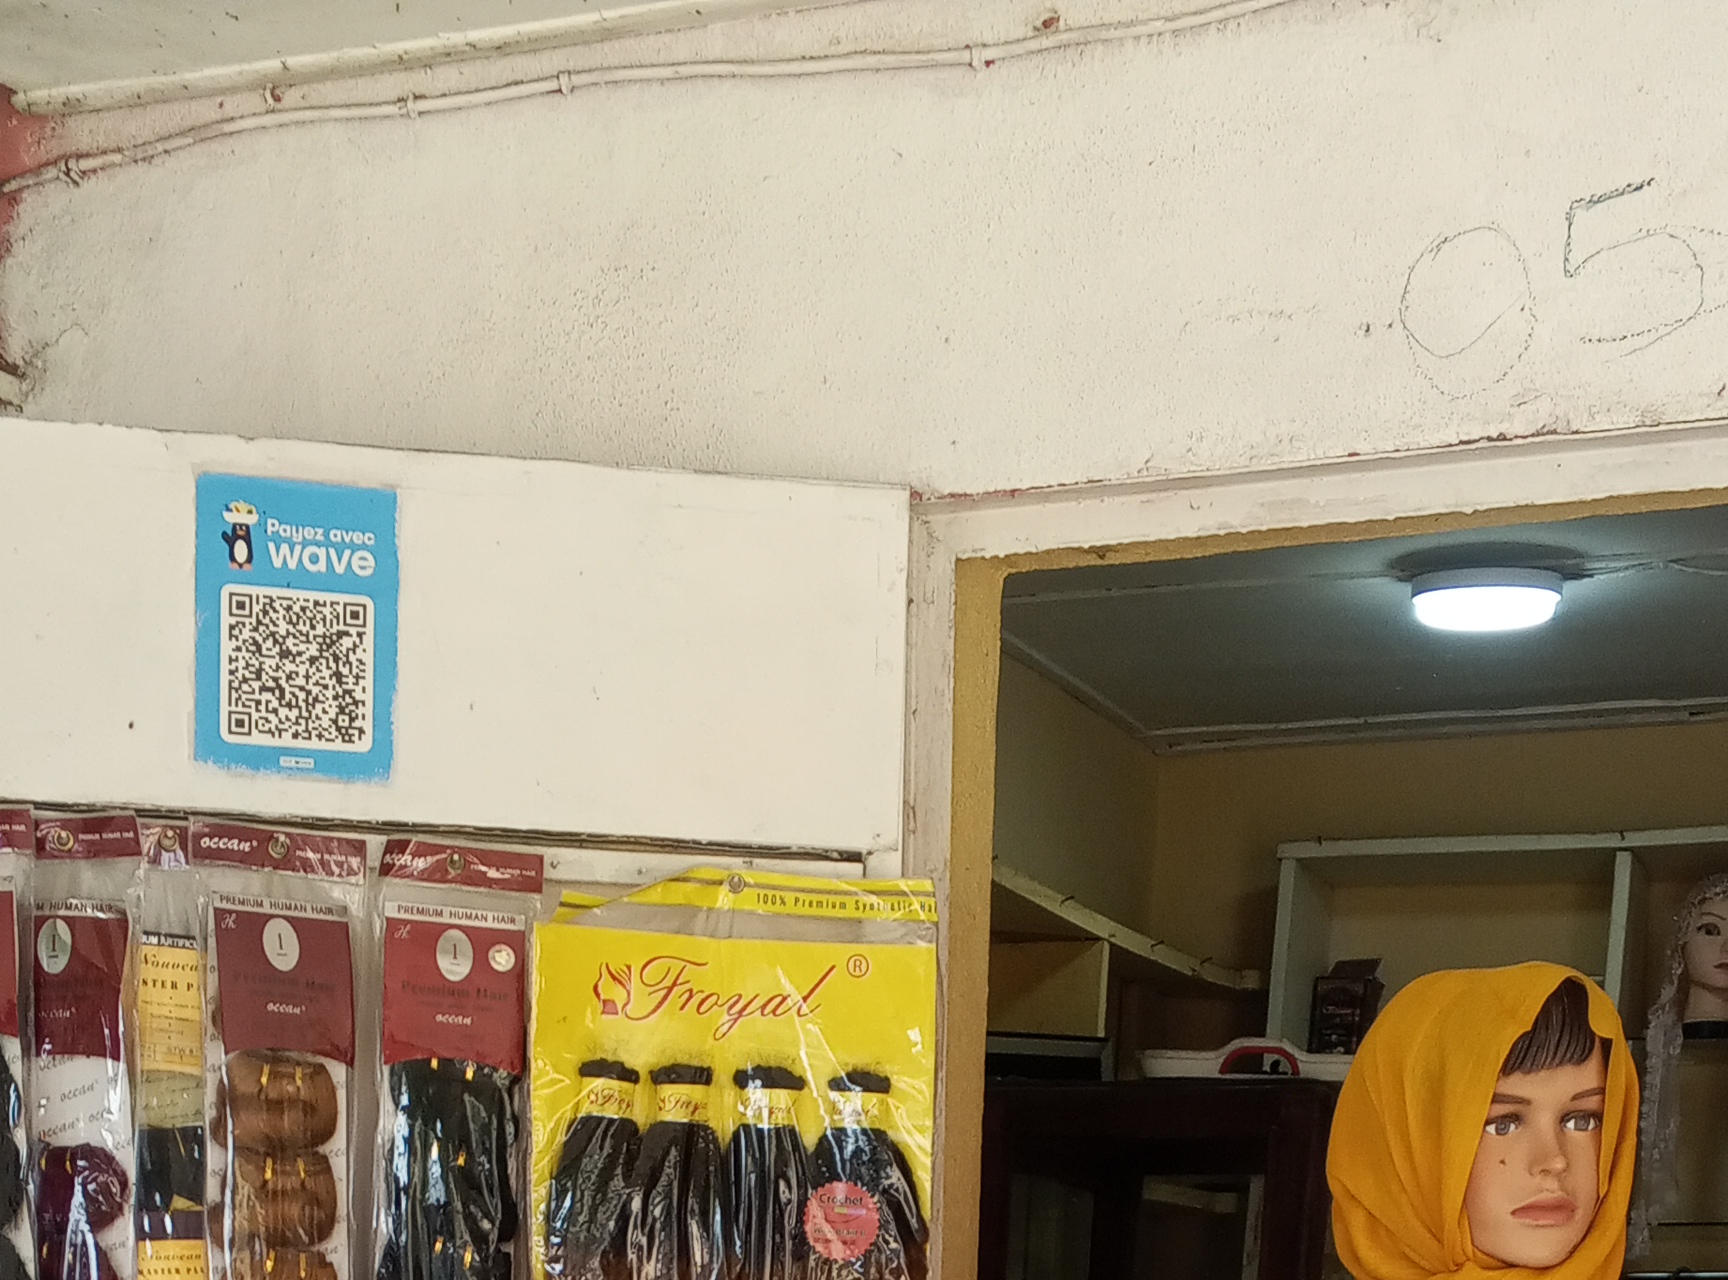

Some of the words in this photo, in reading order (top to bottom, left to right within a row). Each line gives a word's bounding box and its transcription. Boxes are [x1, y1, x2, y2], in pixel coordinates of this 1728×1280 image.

[266, 518, 325, 543] Payez
[329, 528, 375, 545] avec
[267, 540, 376, 577] wave
[50, 901, 88, 913] HUMAN
[219, 894, 264, 909] PREMIUM
[269, 900, 307, 914] HUMAN
[311, 905, 334, 916] HAIR
[757, 892, 786, 907] 100%
[794, 896, 847, 910] Premium
[920, 901, 937, 914] Hai
[397, 904, 444, 918] PREMIUM
[448, 907, 488, 922] HUMAN
[492, 914, 517, 926] HAIR
[624, 955, 836, 1041] Froyal
